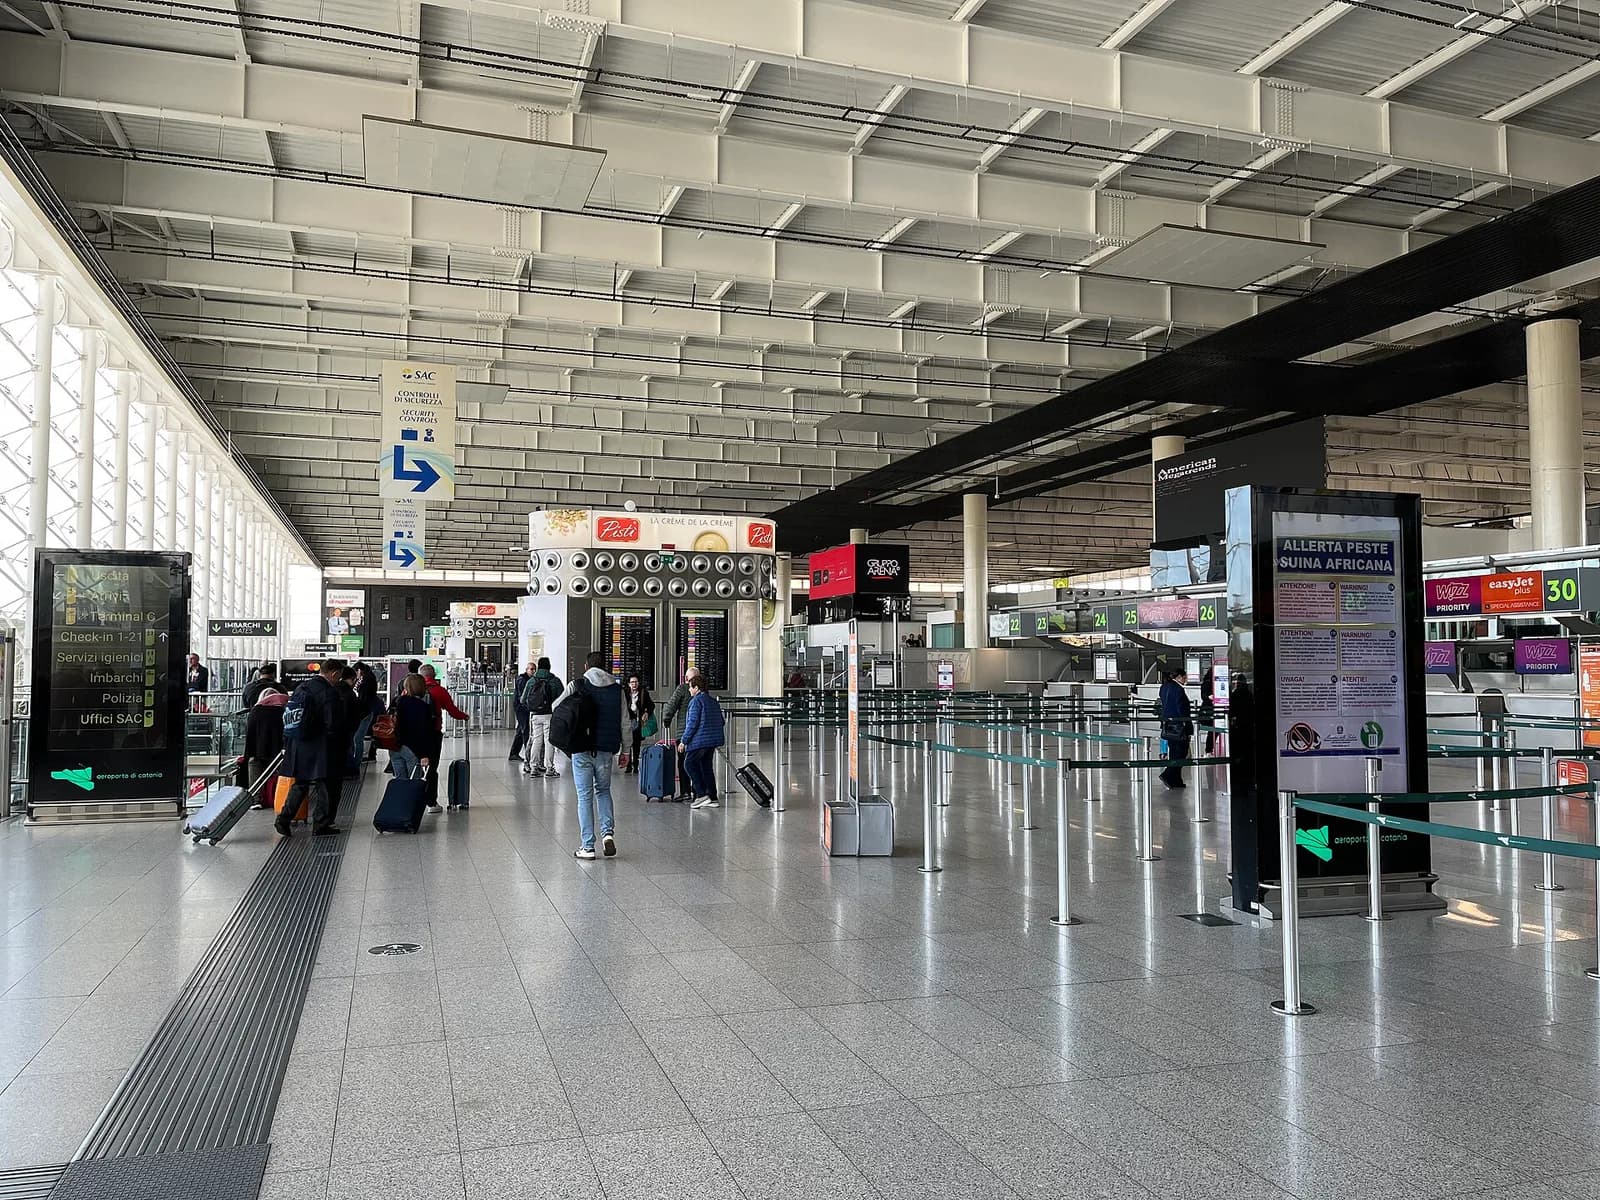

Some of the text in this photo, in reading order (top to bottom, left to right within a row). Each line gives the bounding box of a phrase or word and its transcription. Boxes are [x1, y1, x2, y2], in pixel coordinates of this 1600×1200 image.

[414, 370, 437, 381] SAC
[398, 390, 439, 399] CONTROLLI
[403, 397, 443, 406] SICUREZZA
[402, 409, 436, 417] SECURITY
[399, 415, 438, 424] CONTROLS
[1157, 457, 1217, 475] American
[1158, 463, 1217, 482] Megatrends
[688, 518, 698, 526] DE
[700, 518, 709, 526] LA
[1283, 540, 1389, 555] ALLERTA PESTE
[867, 559, 899, 567] GRUPPO
[1280, 556, 1393, 572] SUINA AFRICANA
[867, 567, 898, 576] ARENA
[1489, 577, 1534, 591] easyJet
[1514, 586, 1531, 596] plus
[1547, 578, 1577, 602] 30
[1436, 603, 1470, 612] PRIORITY
[1511, 601, 1540, 609] ASSISTANCE
[90, 611, 156, 622] Terminal C
[1125, 610, 1138, 626] 25
[1200, 605, 1215, 621] 26
[1010, 618, 1020, 631] 22
[1037, 617, 1047, 630] 23
[1094, 612, 1107, 627] 24
[60, 631, 142, 642] Check-in 1-21
[57, 652, 144, 665] Servizi igienici
[90, 672, 143, 683] Imbarchi
[102, 693, 143, 703] Polizia
[80, 713, 143, 724] Uffici SAC
[96, 773, 129, 781] aeroporto
[1380, 832, 1408, 842] catania
